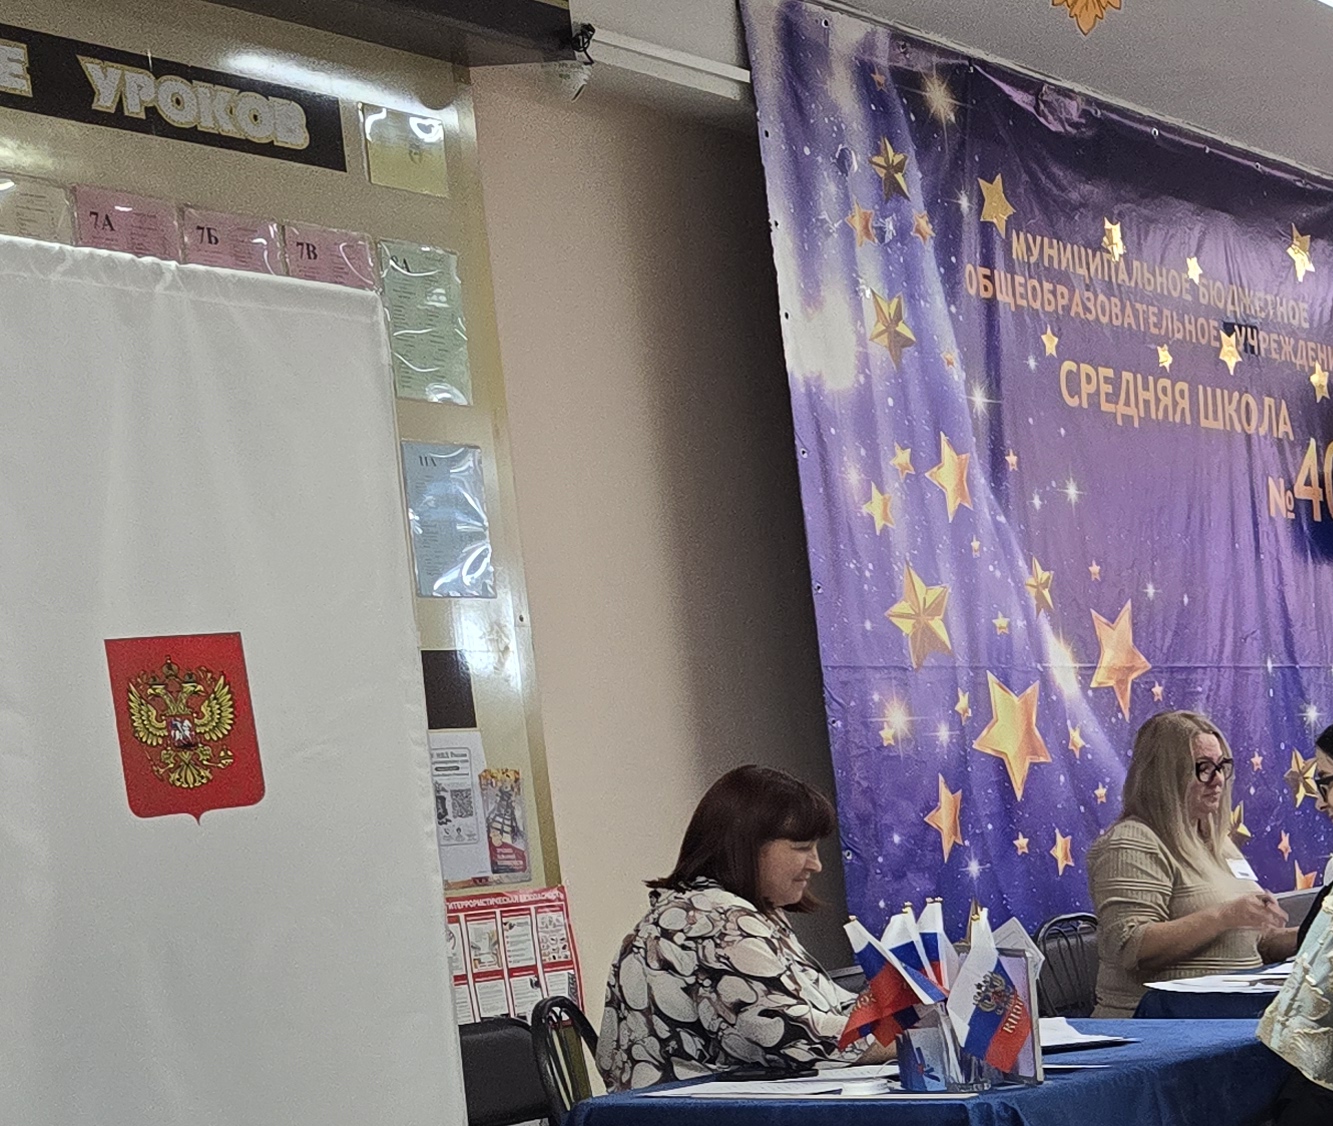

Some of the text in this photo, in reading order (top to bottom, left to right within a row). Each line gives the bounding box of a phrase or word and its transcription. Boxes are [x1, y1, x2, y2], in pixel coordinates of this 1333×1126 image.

[76, 54, 311, 150] УРОКОВ
[89, 212, 115, 232] 7А
[196, 226, 219, 245] 7Б
[296, 242, 318, 260] 7В
[965, 265, 1220, 348] ОБЩЕОБРАЗОВАТЕЛЬНОЕ
[1011, 229, 1311, 328] МУНИЦИПАЛЬНОЕ БЮДЖЕТНОЕ
[1060, 360, 1294, 441] СРЕДНЯЯ ШКОЛА
